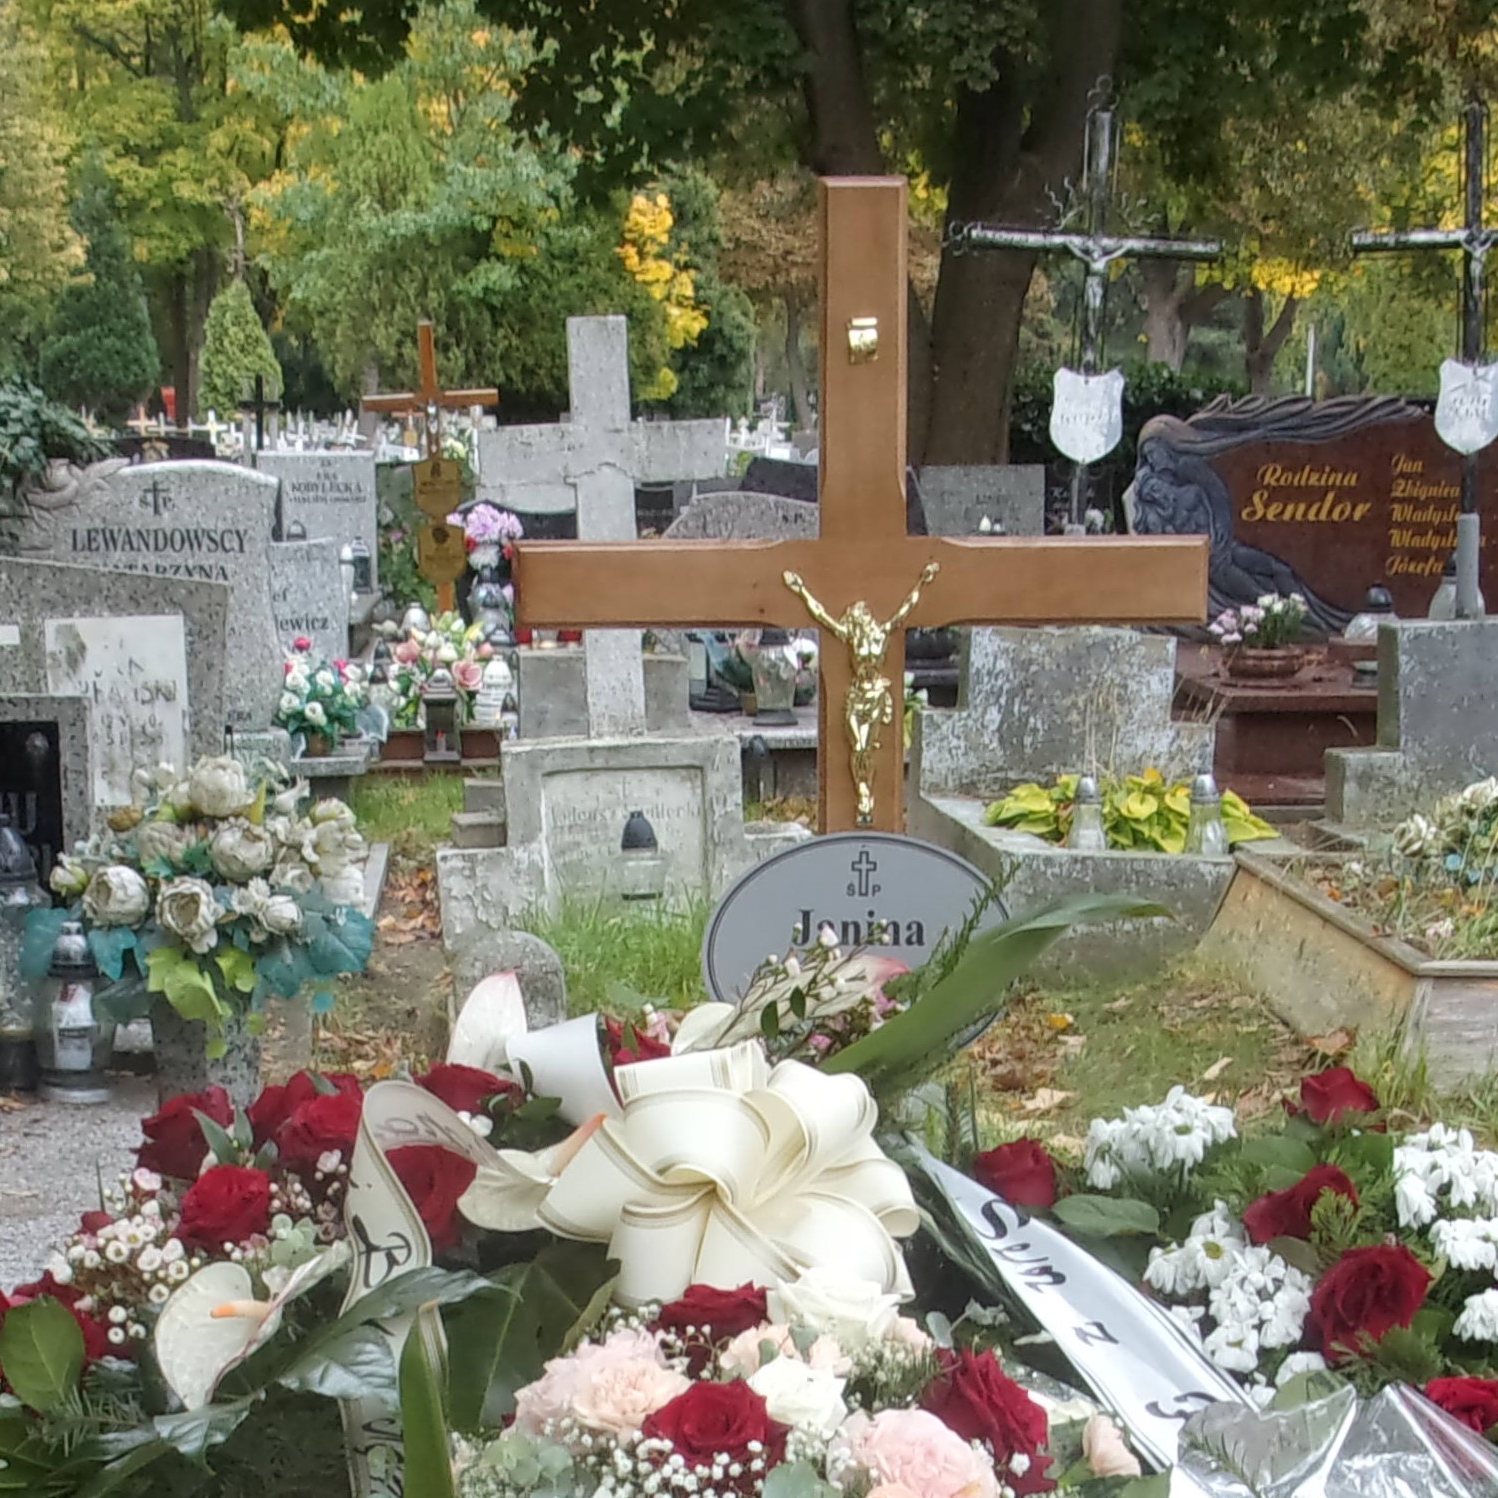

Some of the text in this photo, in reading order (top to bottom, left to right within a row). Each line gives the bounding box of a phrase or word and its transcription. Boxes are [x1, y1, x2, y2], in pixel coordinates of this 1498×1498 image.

[1257, 463, 1359, 487] Rodzina
[1391, 454, 1424, 475] Jan
[1241, 489, 1372, 522] Sendor
[71, 527, 249, 554] LEWANDOWSCY
